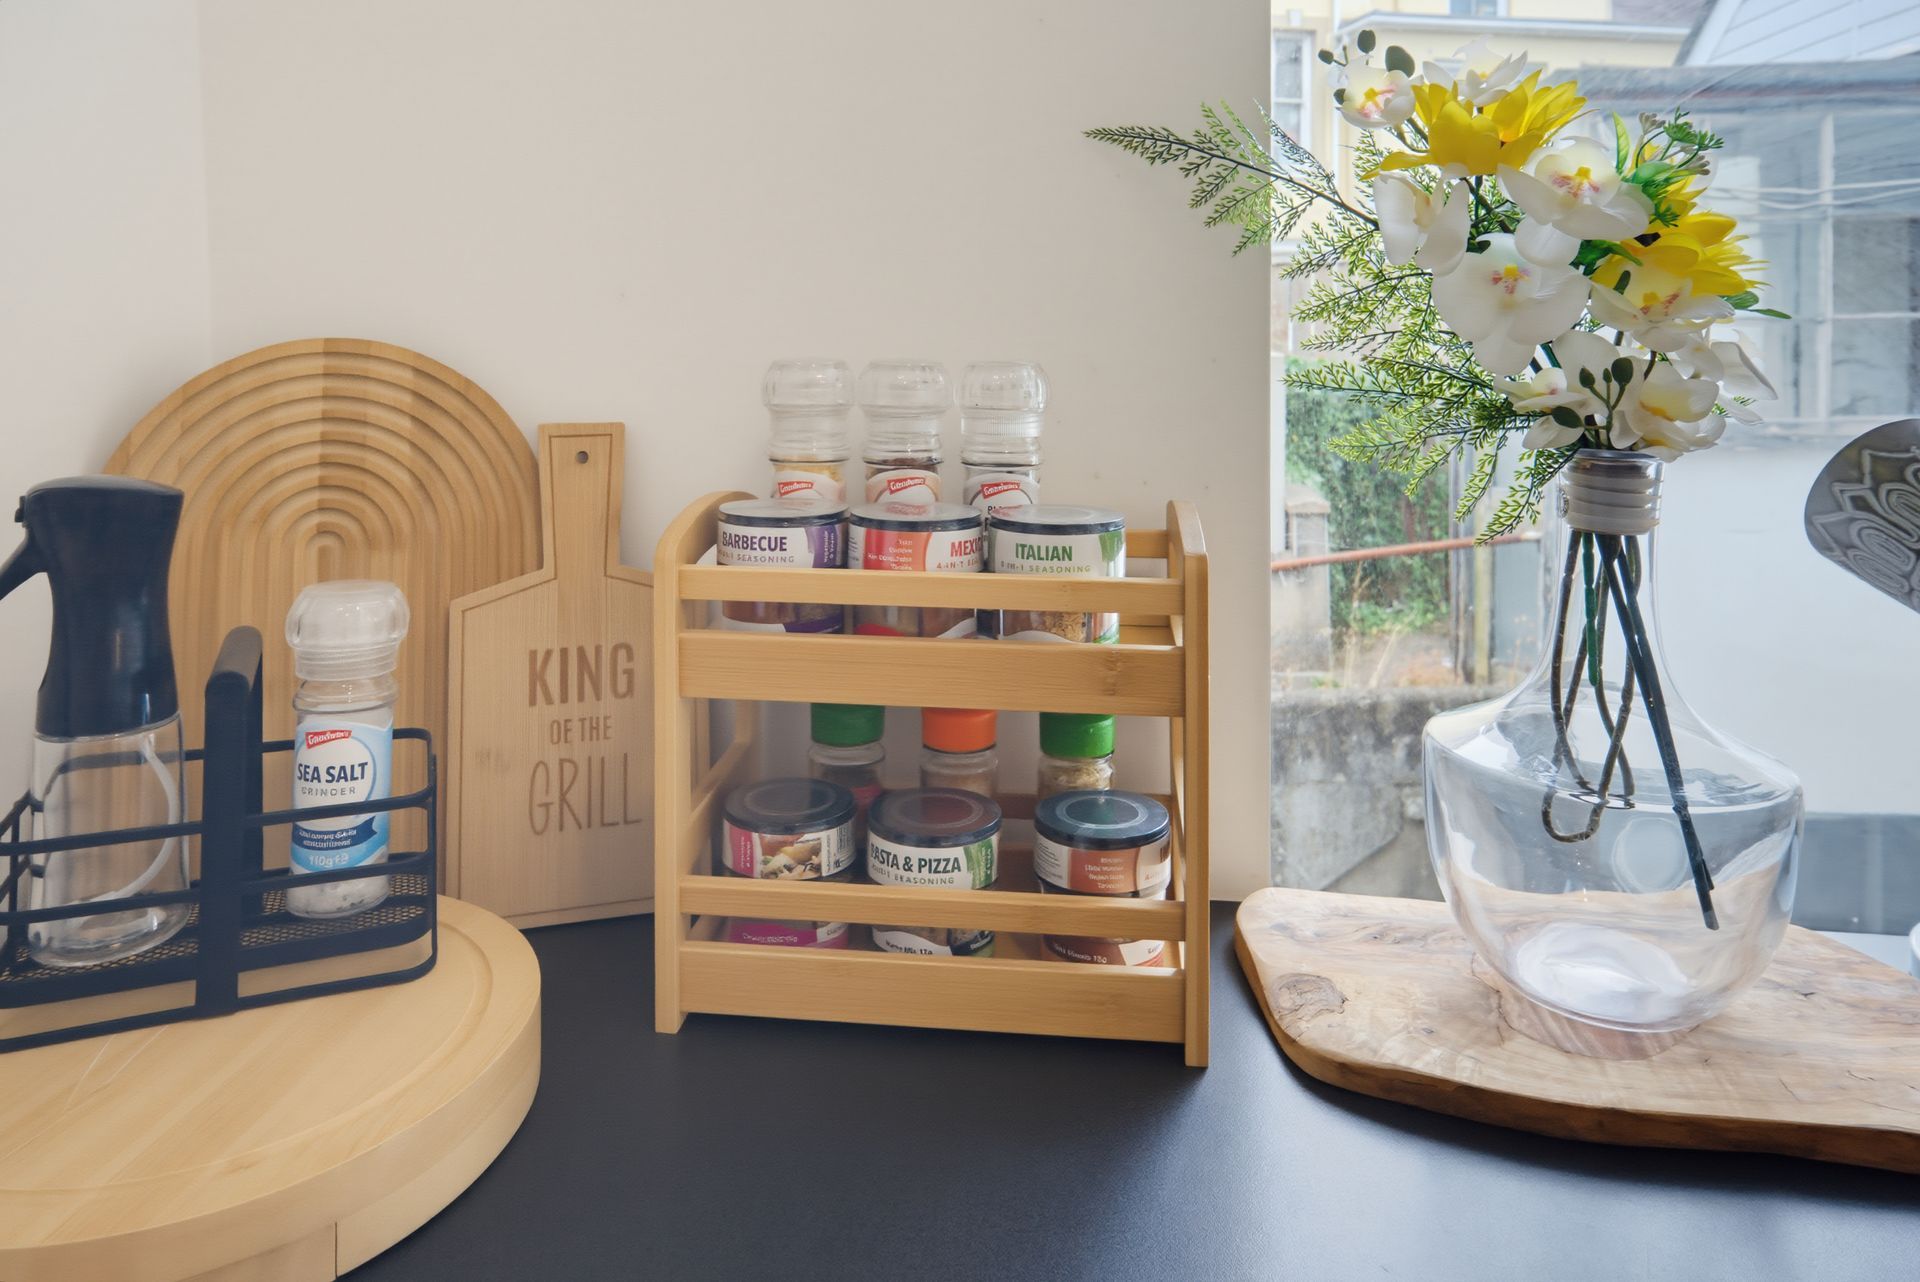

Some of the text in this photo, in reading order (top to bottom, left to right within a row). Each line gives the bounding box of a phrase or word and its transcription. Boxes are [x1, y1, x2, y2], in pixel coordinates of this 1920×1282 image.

[721, 530, 788, 552] BARBECUE
[1015, 542, 1073, 562] ITALIAN
[737, 553, 795, 564] SEASONING
[1028, 564, 1092, 574] SEASONING
[528, 642, 635, 707] KING
[550, 715, 612, 745] OF THE
[297, 761, 369, 784] SEA SALT
[301, 786, 356, 797] GRINDER
[528, 752, 642, 836] GRILL
[870, 843, 900, 871] PASTA
[902, 856, 914, 873] &
[917, 857, 962, 874] PIZZA
